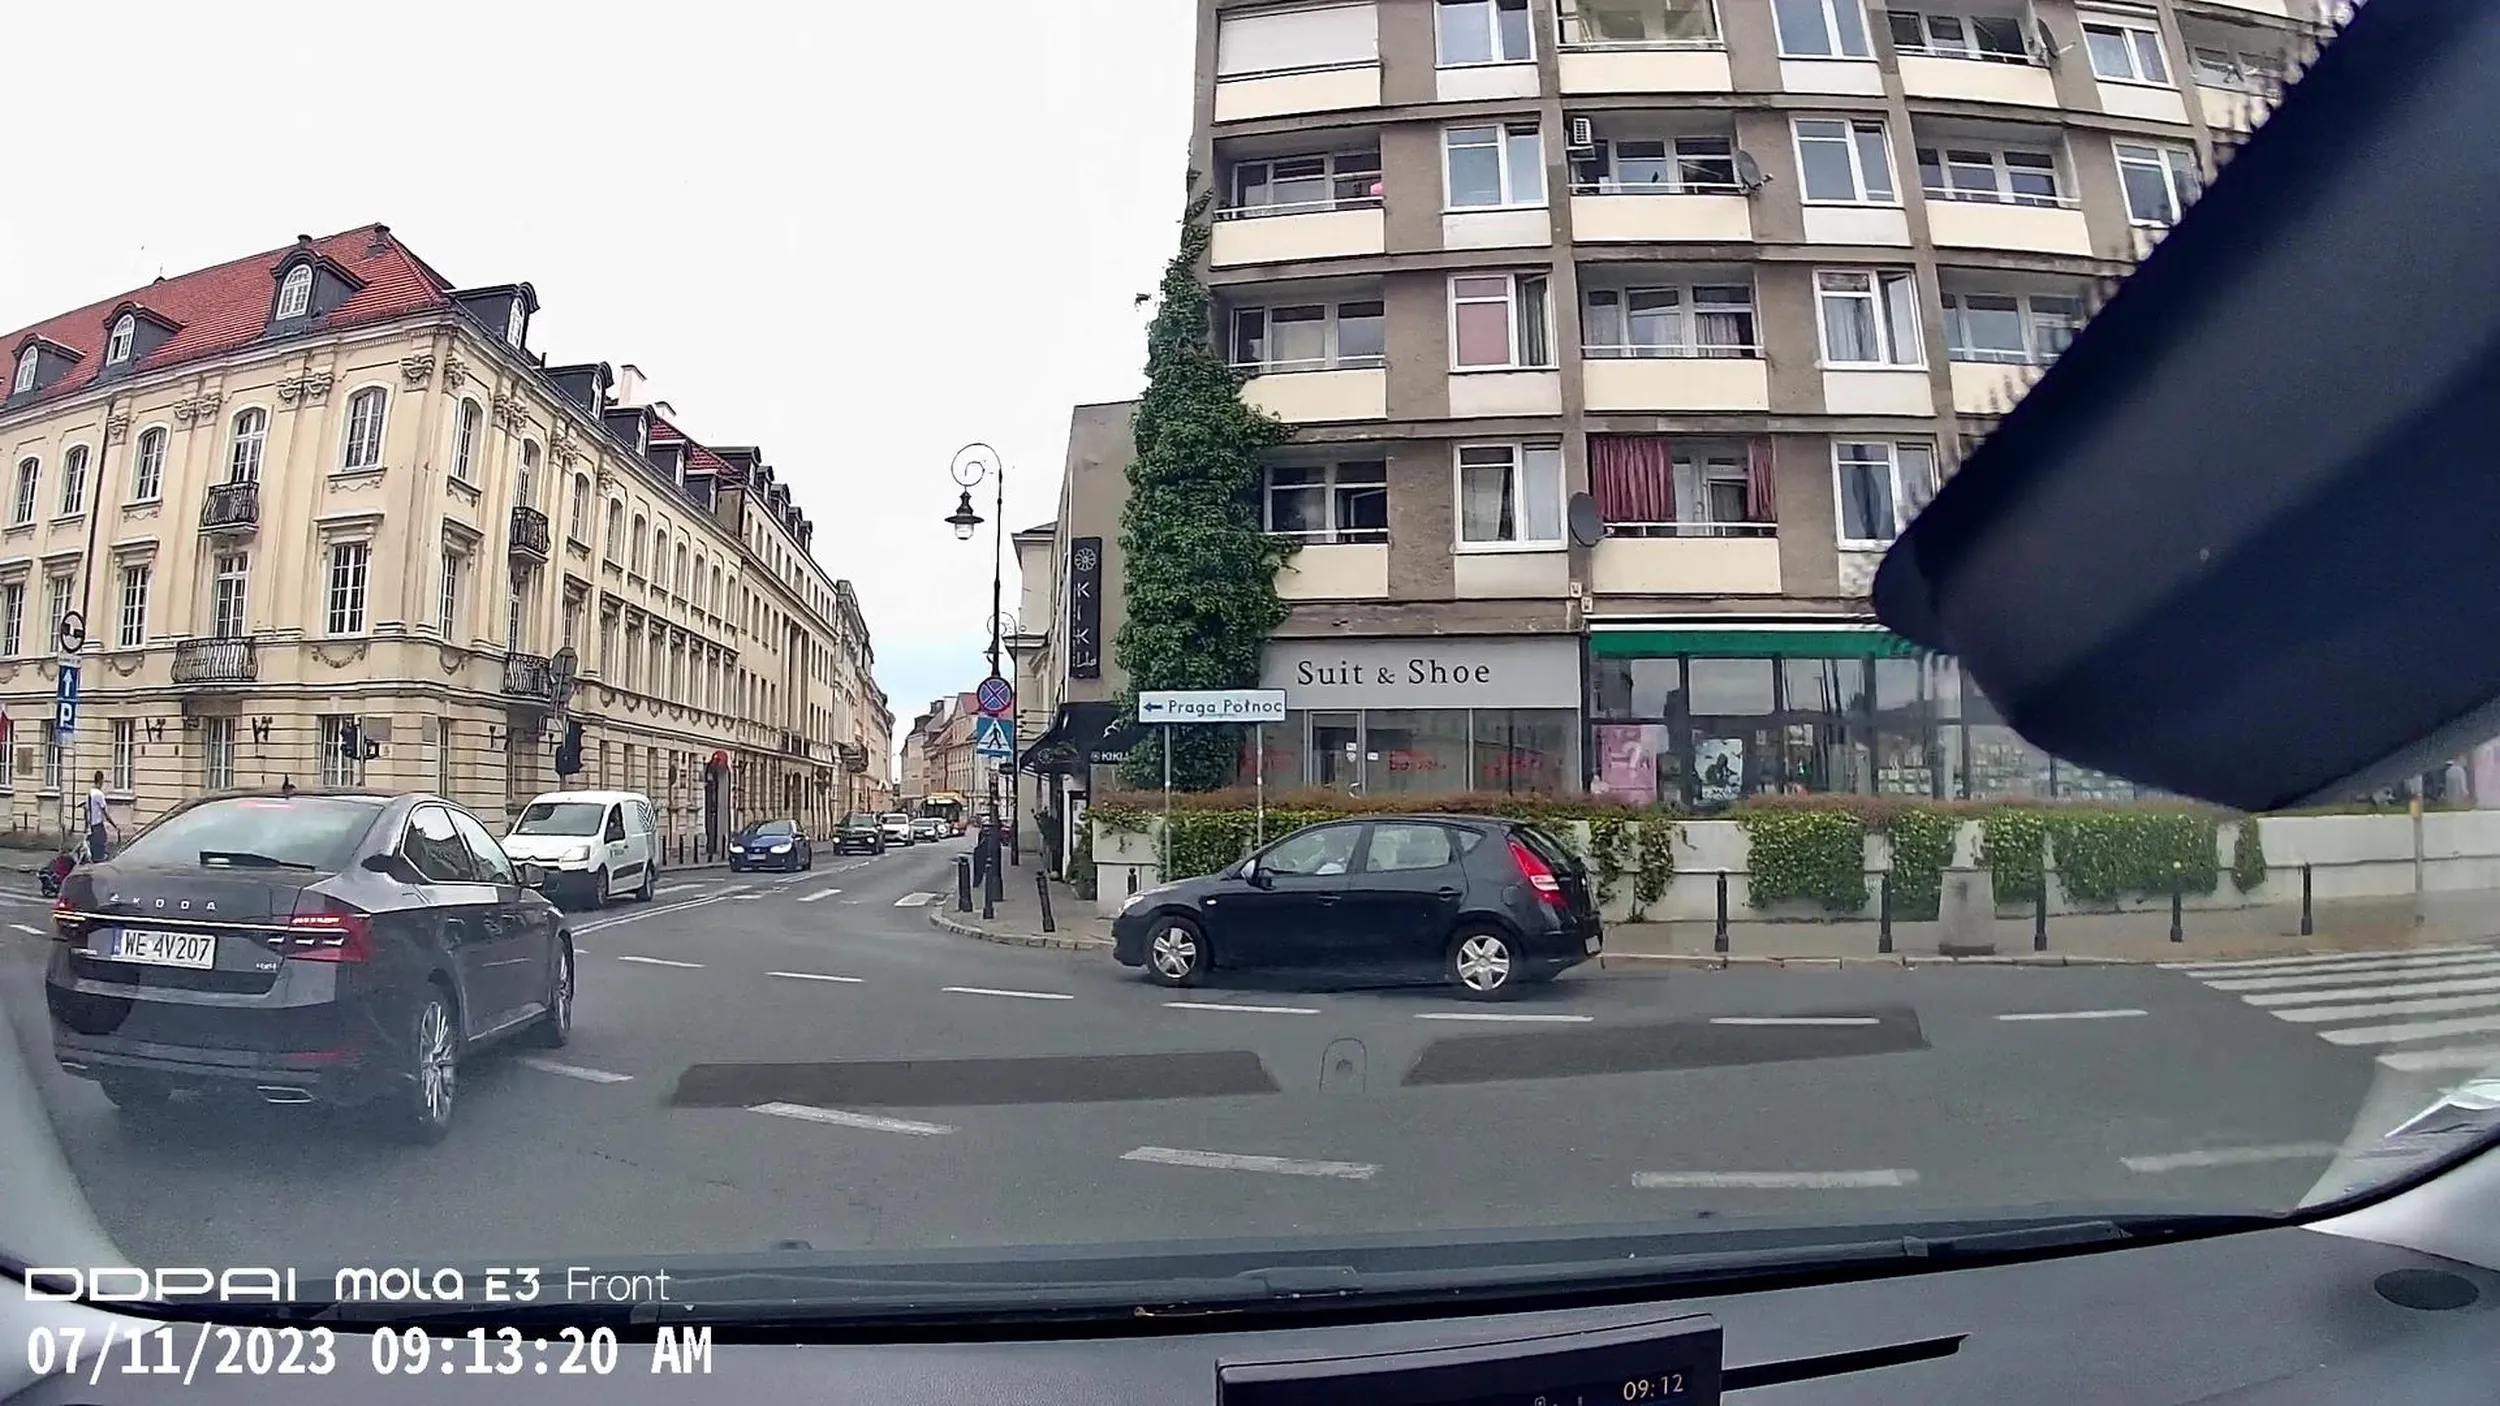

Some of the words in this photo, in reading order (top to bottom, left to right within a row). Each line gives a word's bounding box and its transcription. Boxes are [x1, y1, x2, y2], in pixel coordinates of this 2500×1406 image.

[1297, 660, 1363, 685] Suit
[1377, 667, 1395, 684] &
[1408, 659, 1490, 684] Shoe
[60, 702, 72, 727] P
[1168, 700, 1216, 717] Praga
[124, 932, 147, 957] WE
[152, 934, 211, 963] 4V207
[1623, 1373, 1684, 1401] 09:12
